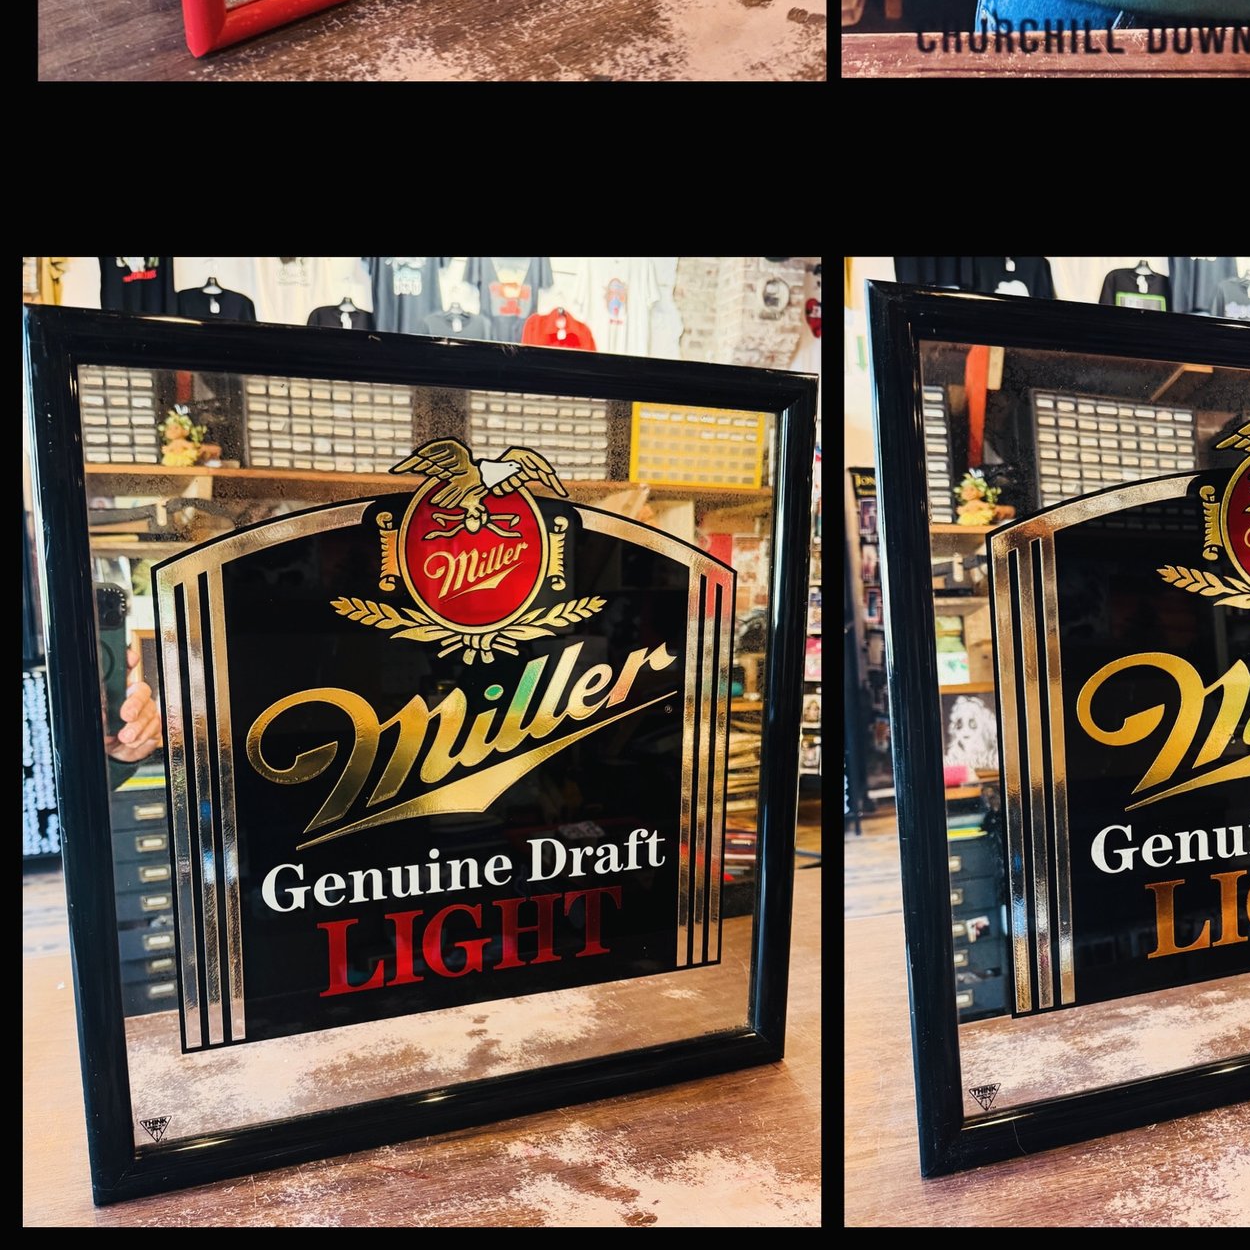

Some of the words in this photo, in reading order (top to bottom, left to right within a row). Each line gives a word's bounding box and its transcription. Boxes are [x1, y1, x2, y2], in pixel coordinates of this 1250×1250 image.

[915, 18, 1125, 55] CHURCHILL
[423, 541, 529, 600] Miller
[246, 640, 678, 842] Miller
[261, 849, 513, 914] Genuine
[526, 828, 667, 882] Draft
[316, 885, 623, 998] LIGHT
